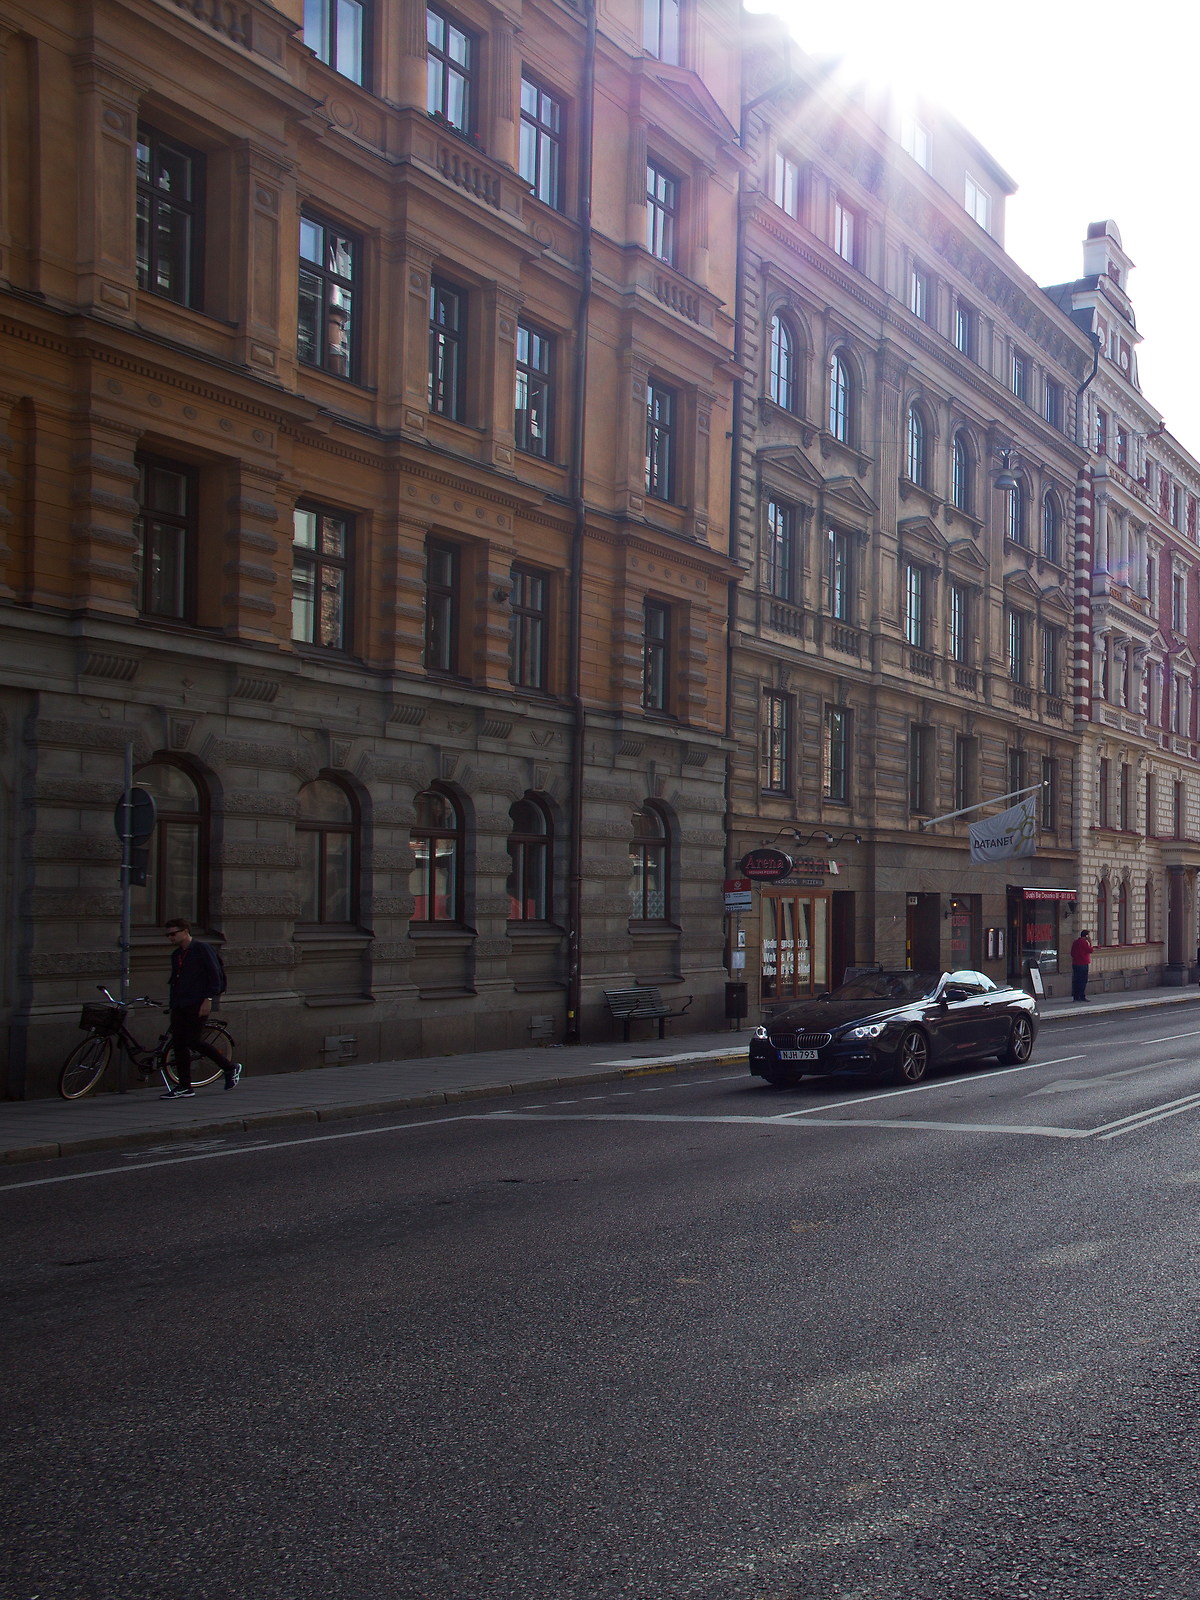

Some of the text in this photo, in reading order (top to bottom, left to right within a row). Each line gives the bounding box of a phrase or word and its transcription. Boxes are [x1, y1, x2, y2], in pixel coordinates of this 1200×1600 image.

[974, 836, 1014, 849] DATANET
[763, 952, 777, 963] Wok
[783, 1051, 815, 1059] NJH 793
